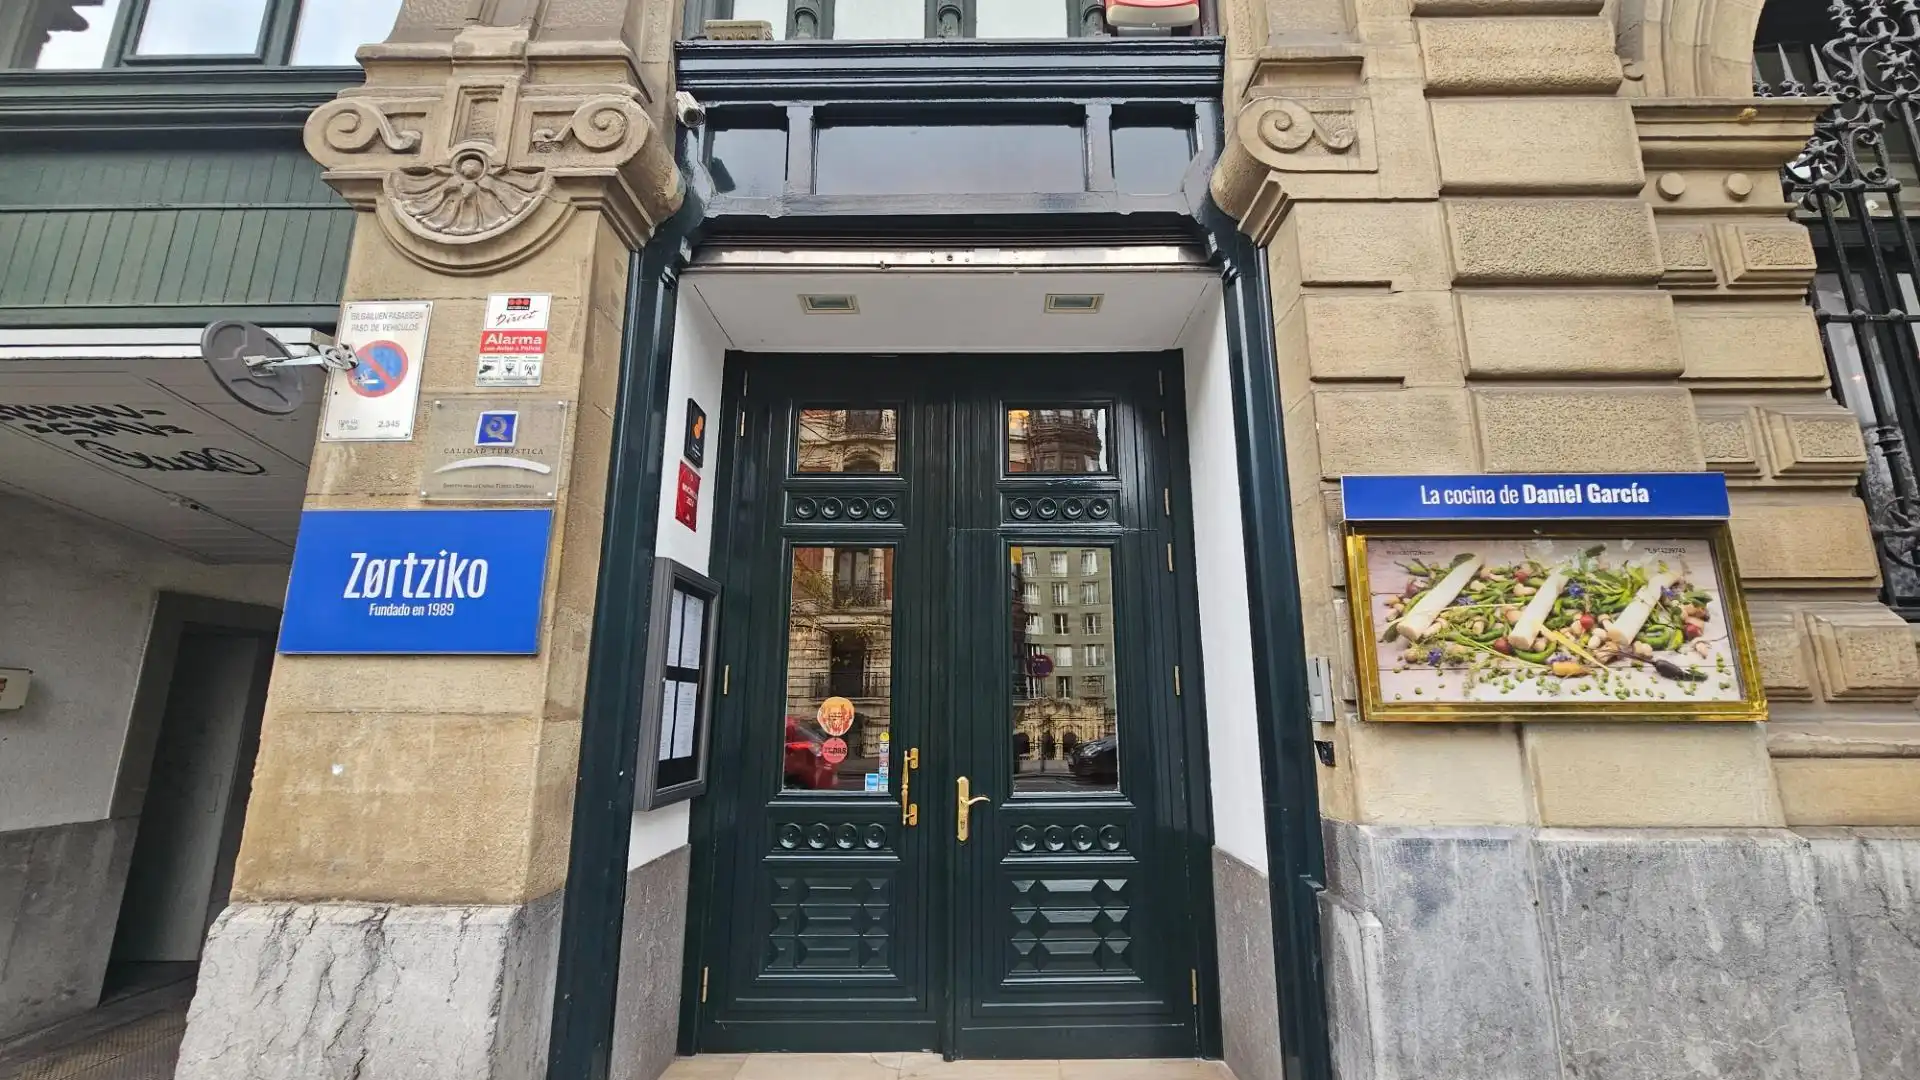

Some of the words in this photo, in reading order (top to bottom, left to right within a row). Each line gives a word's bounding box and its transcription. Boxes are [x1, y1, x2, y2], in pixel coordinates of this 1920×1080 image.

[351, 323, 368, 332] PASO
[370, 323, 380, 332] DE
[485, 332, 542, 345] Alarma
[443, 447, 488, 455] CALIDAD
[1421, 485, 1440, 505] La
[1443, 485, 1496, 505] cocina
[1499, 485, 1519, 504] de
[1523, 483, 1582, 505] Daniel
[1587, 482, 1649, 504] García
[343, 548, 489, 599] Zørtziko
[368, 603, 410, 617] Fundado
[412, 605, 424, 616] en
[427, 603, 454, 617] 1989
